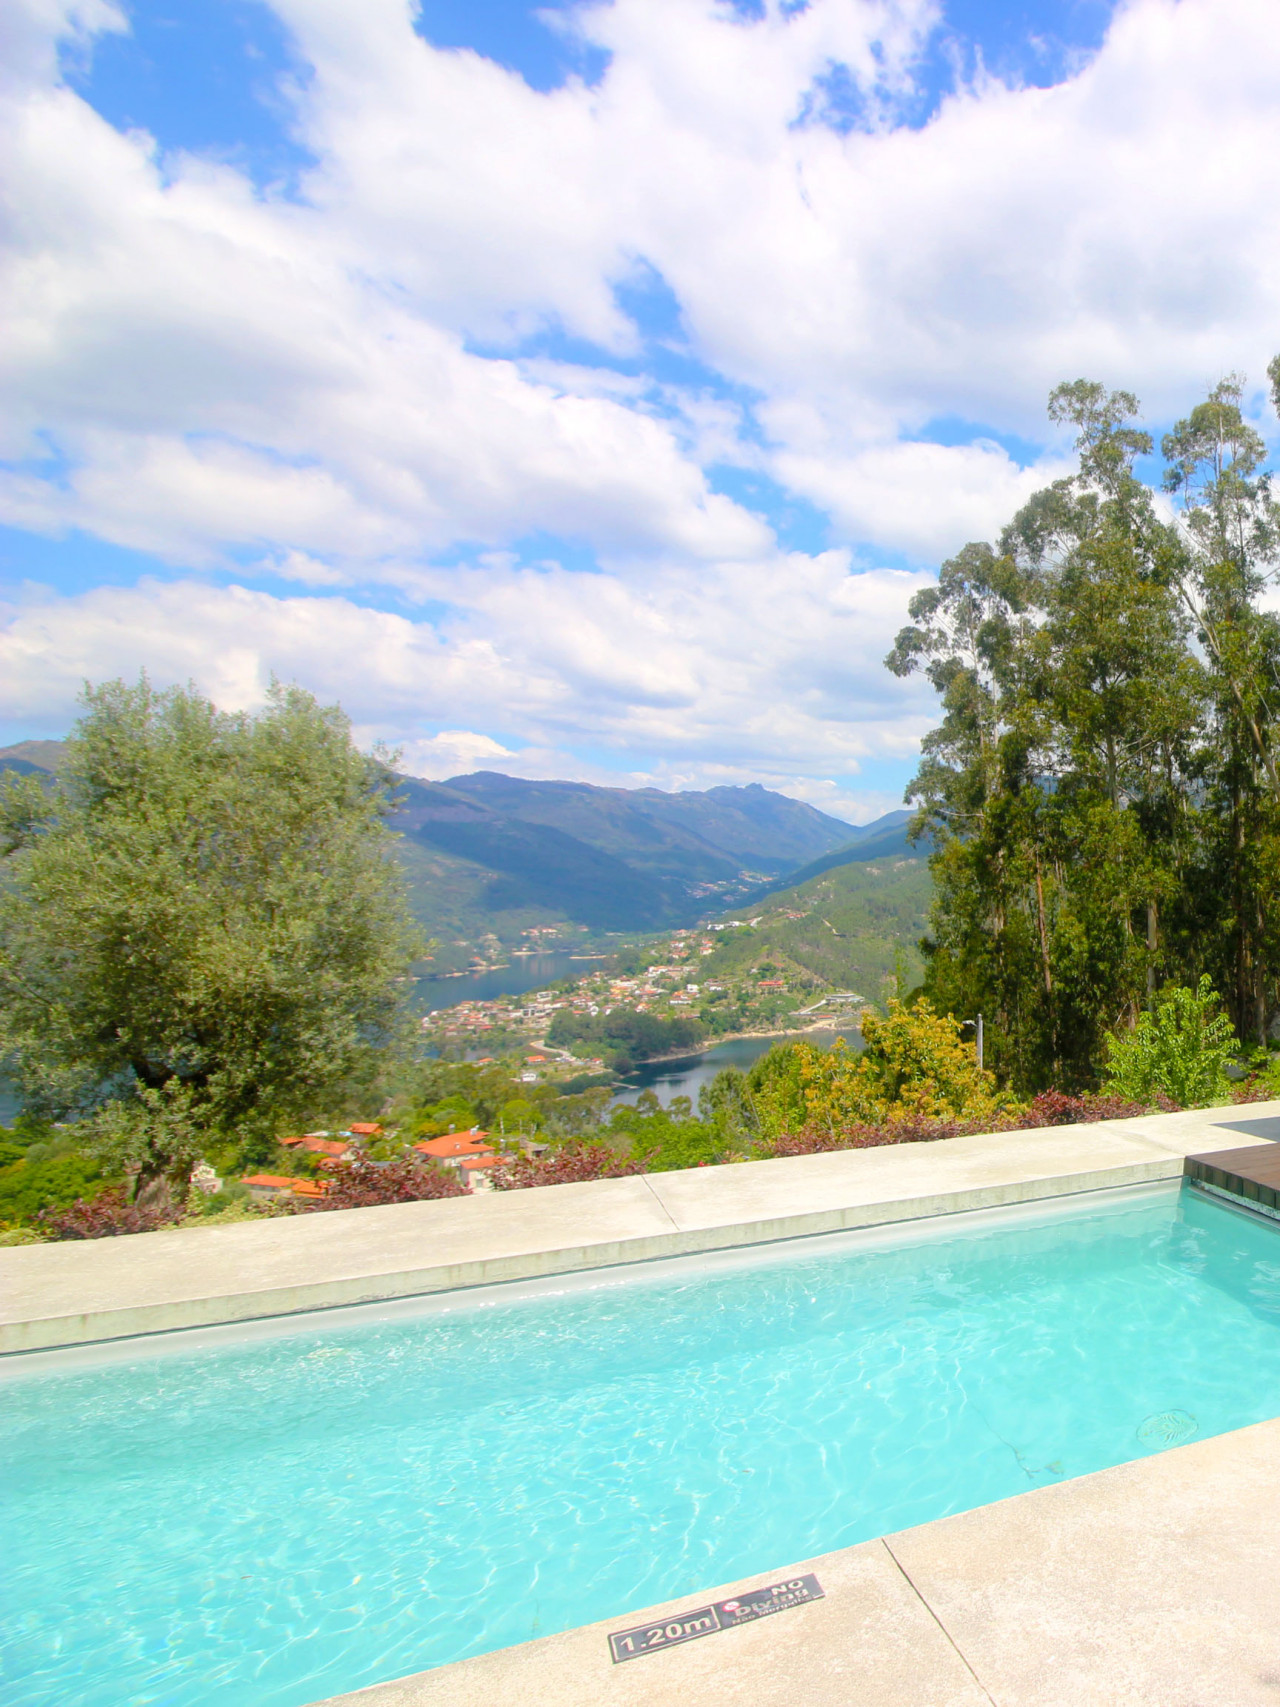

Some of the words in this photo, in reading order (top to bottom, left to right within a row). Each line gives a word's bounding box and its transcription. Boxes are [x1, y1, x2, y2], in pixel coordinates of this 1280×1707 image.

[734, 1588, 809, 1617] Diving
[771, 1580, 804, 1596] NO
[620, 1616, 711, 1651] 1.20m
